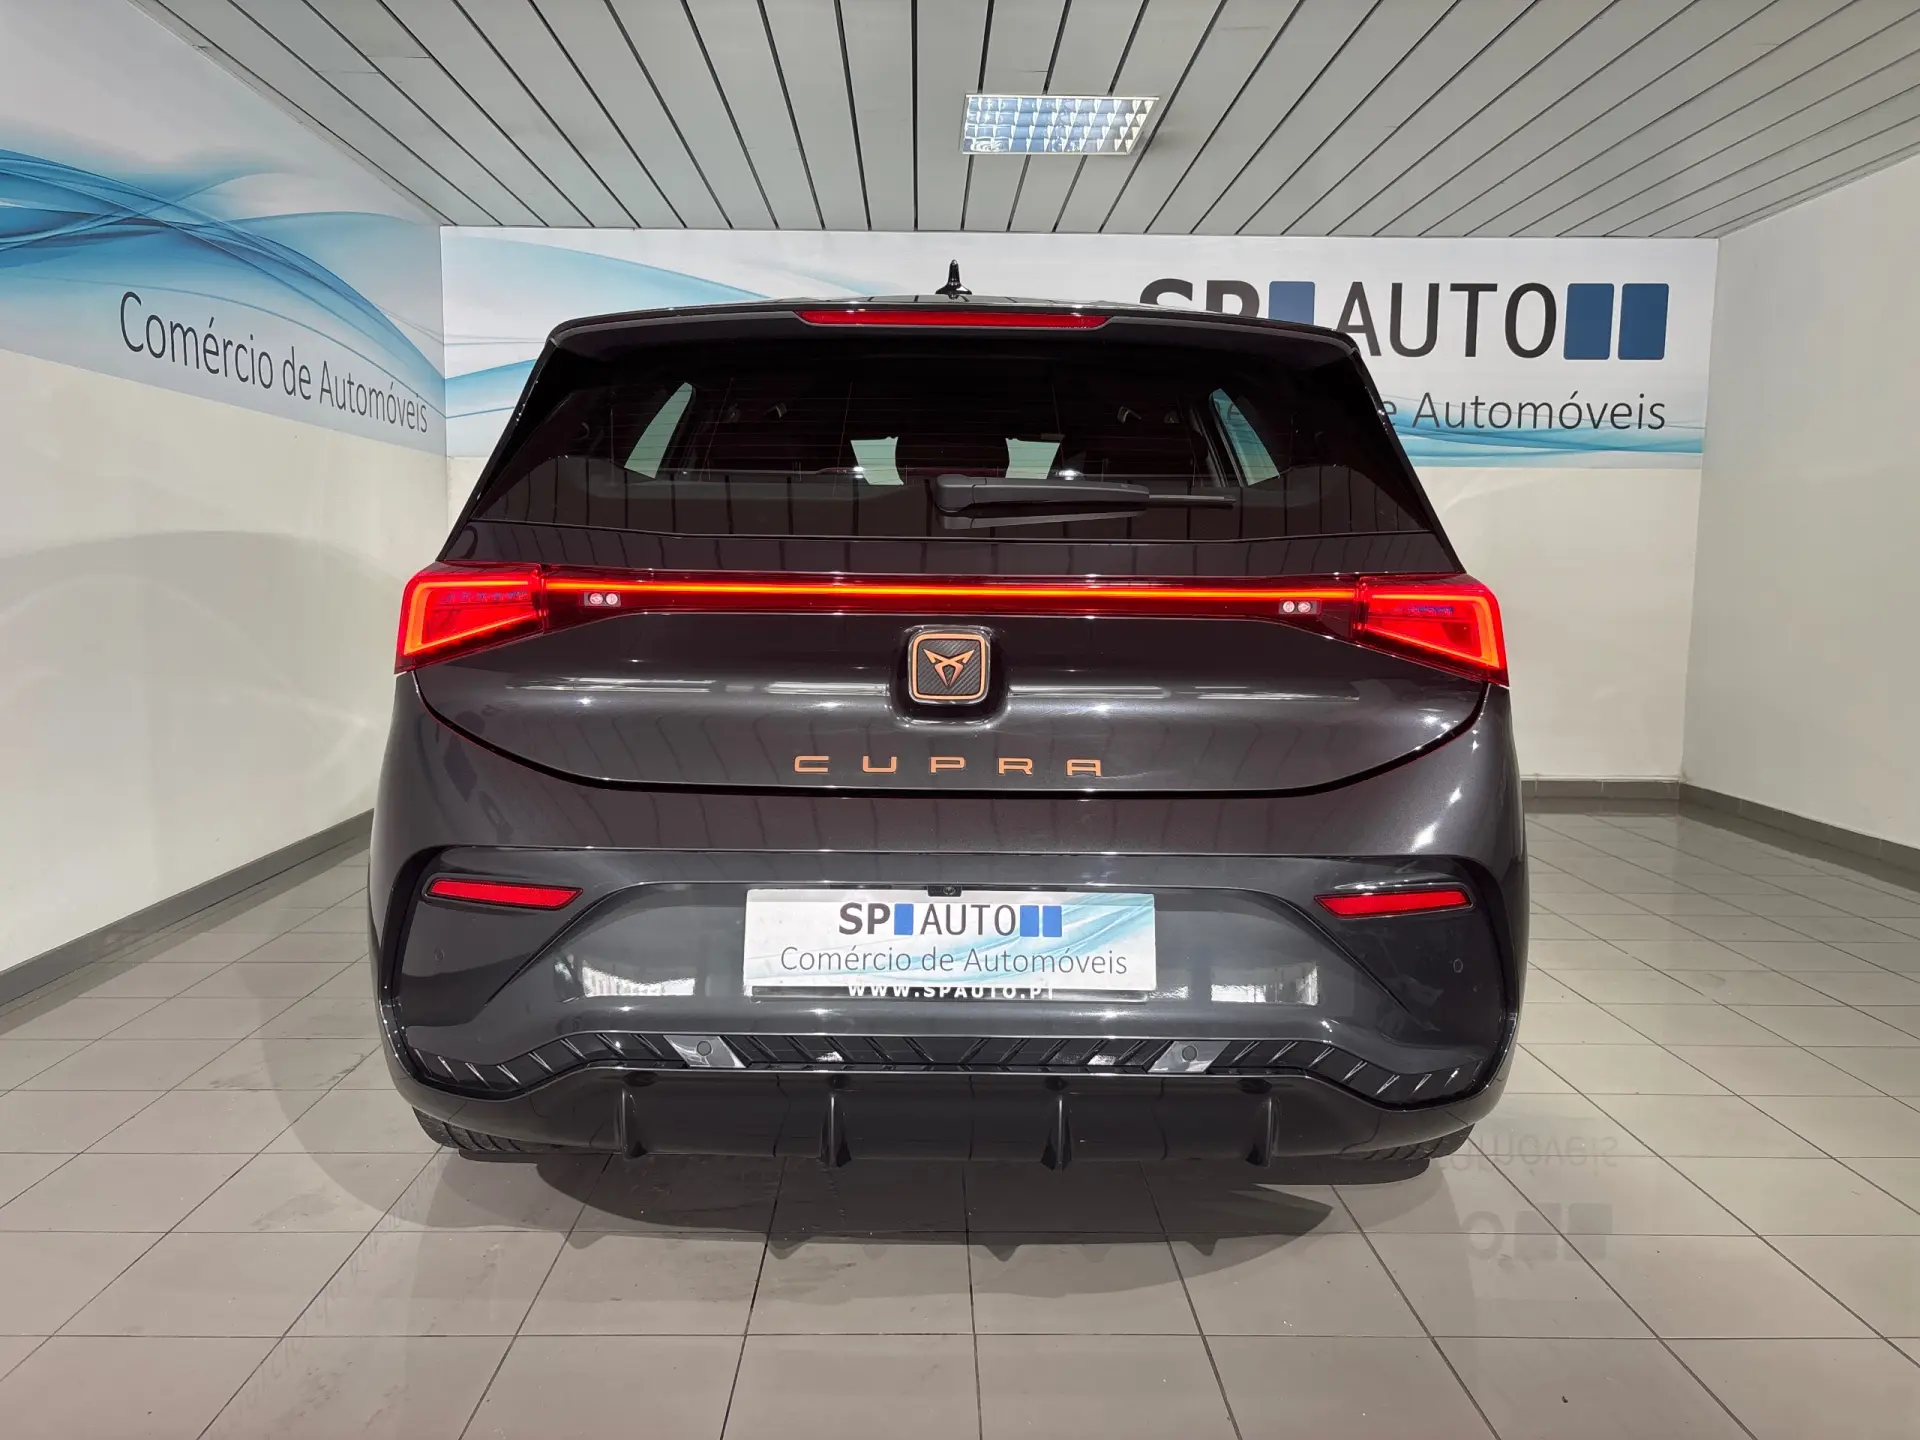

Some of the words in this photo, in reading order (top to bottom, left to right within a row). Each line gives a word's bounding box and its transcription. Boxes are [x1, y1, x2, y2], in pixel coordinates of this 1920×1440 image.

[1336, 282, 1557, 359] AUTO
[120, 291, 273, 389] Comércio
[282, 345, 312, 400] de
[319, 360, 428, 433] Automóveis
[1411, 391, 1666, 430] Automóveis
[794, 755, 1102, 777] CUPRA
[838, 902, 890, 936] SP
[920, 904, 1017, 937] AUTO
[780, 945, 911, 973] Comércio
[921, 946, 953, 973] de
[964, 947, 1128, 975] Automóveis
